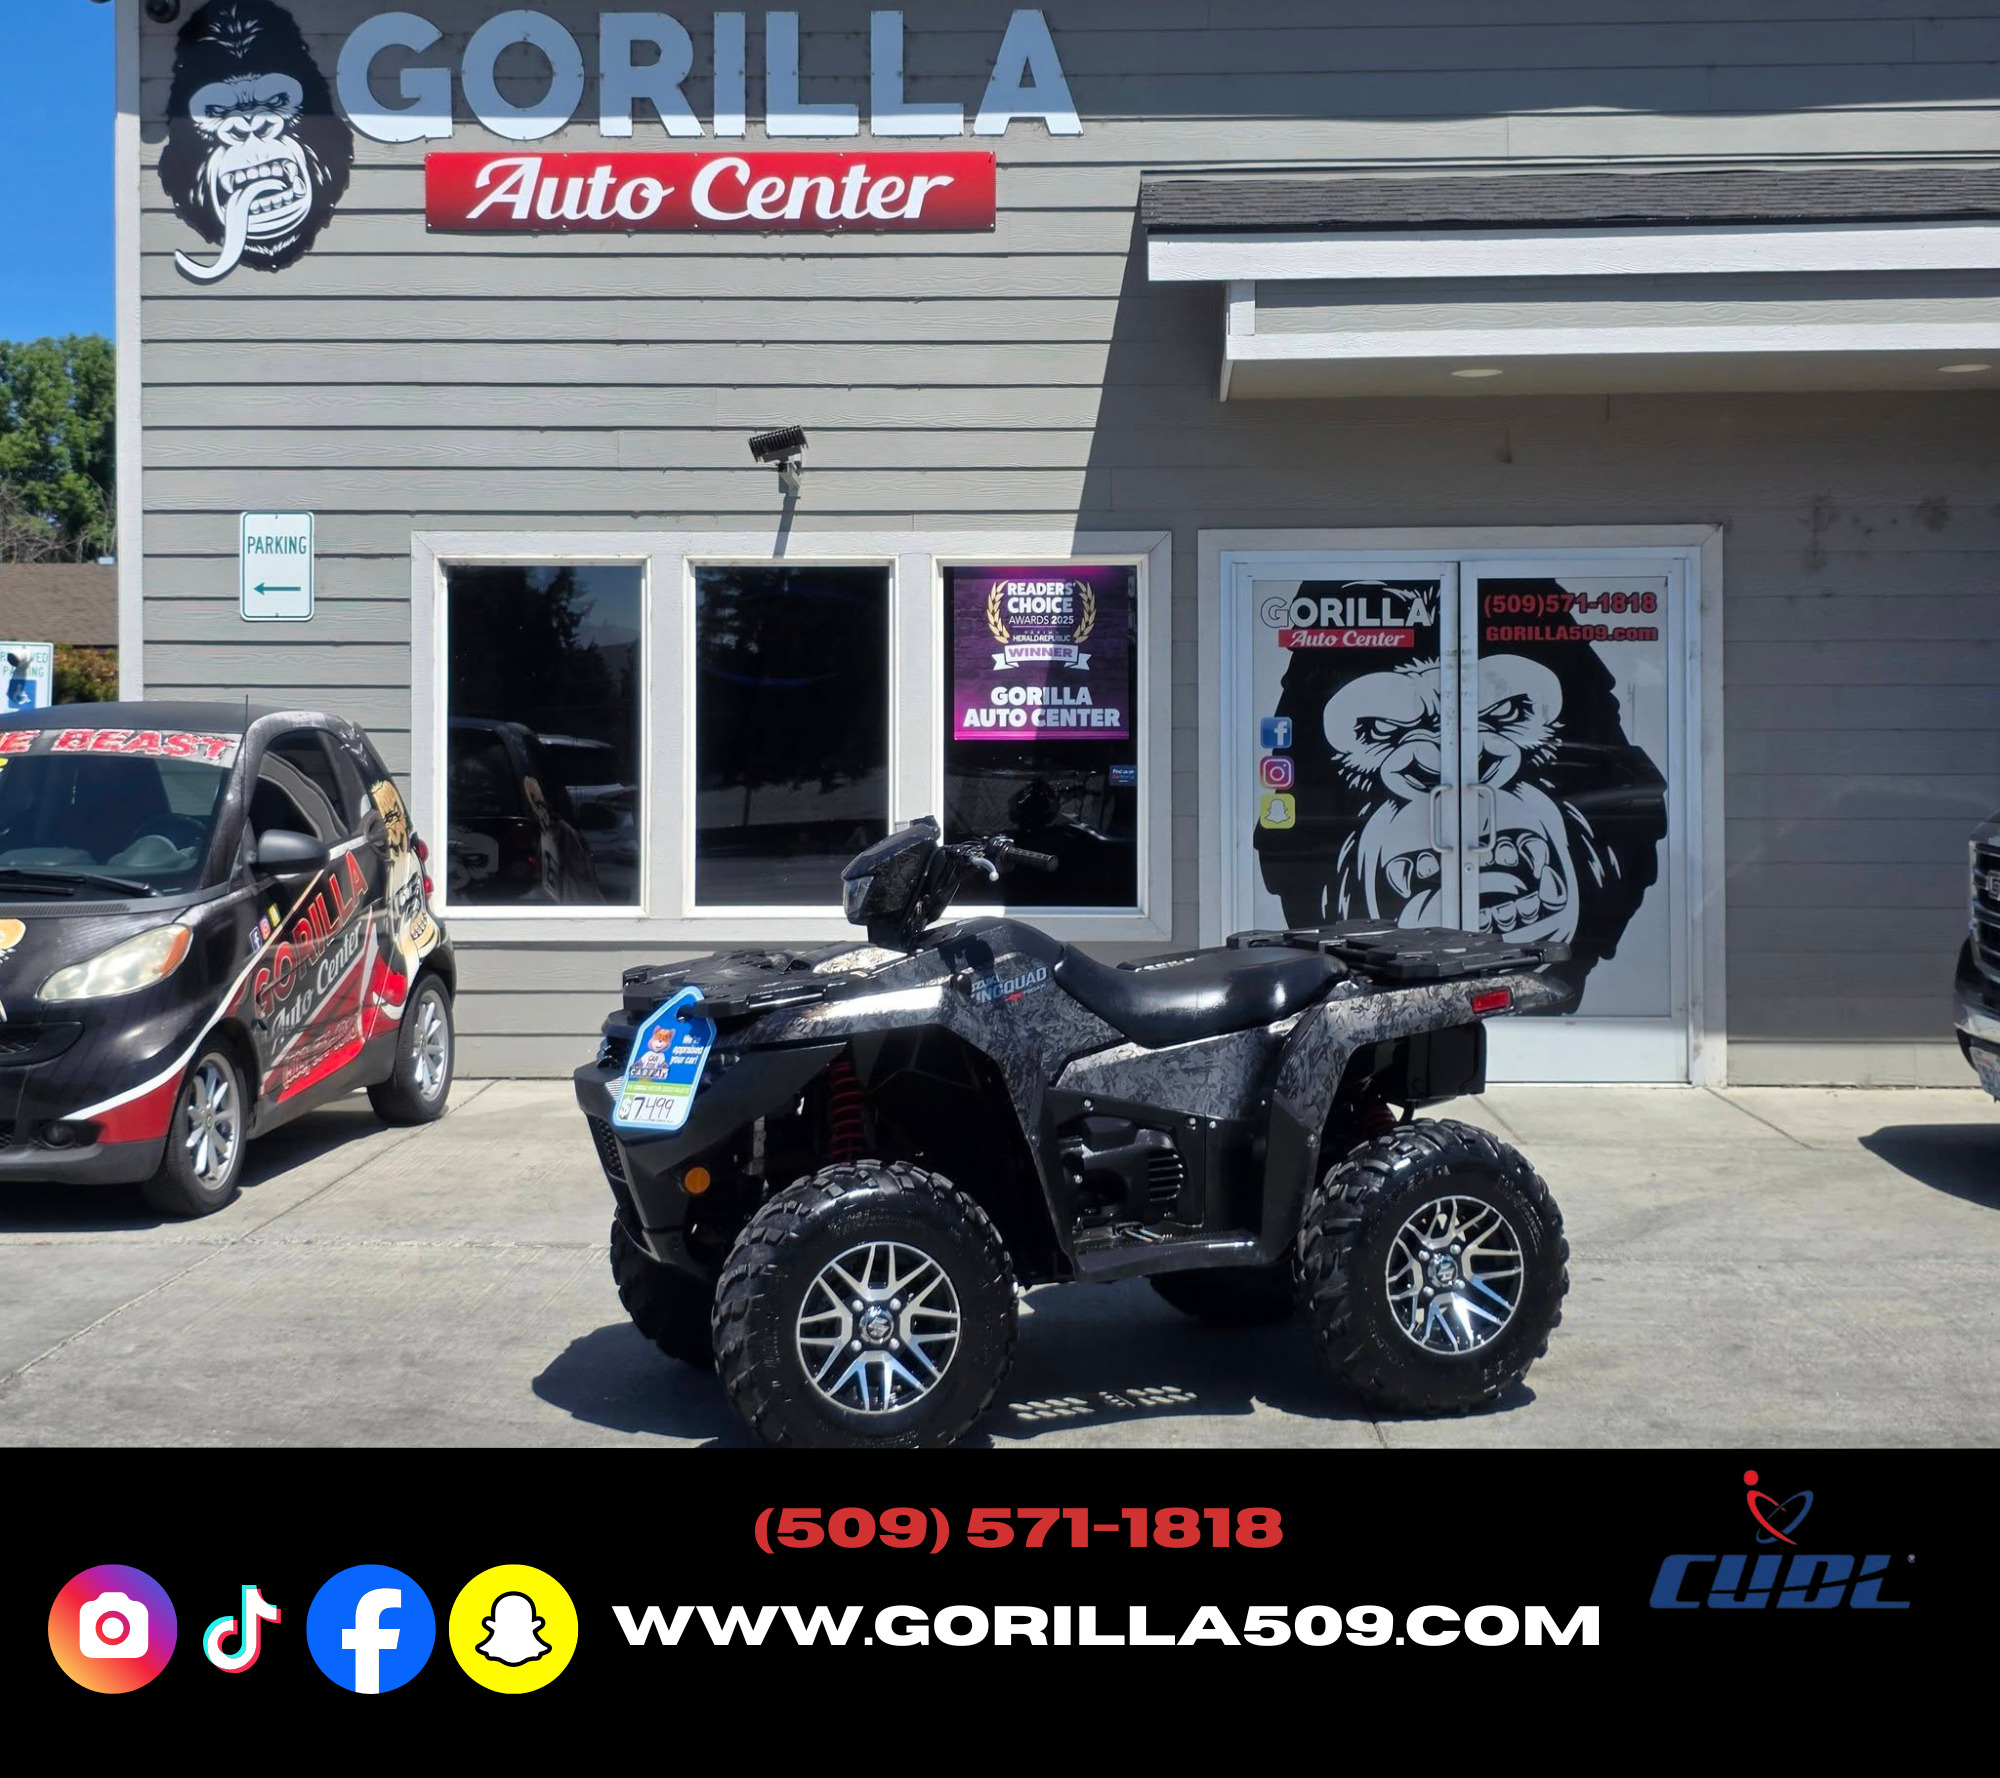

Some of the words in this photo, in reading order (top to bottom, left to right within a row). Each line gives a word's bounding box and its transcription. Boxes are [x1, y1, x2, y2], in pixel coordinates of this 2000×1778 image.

[336, 9, 1083, 142] GORILLA
[466, 157, 675, 220] Auto
[690, 157, 954, 221] Center
[247, 536, 307, 554] PARKING
[1007, 597, 1074, 614] CHOICE
[1260, 596, 1433, 629] GORILLA
[1484, 592, 1658, 617] (509)571-1818
[1008, 615, 1050, 625] AWARDS
[1051, 615, 1074, 625] 2025
[1290, 630, 1337, 647] Auto
[1342, 630, 1405, 648] Center
[1486, 625, 1658, 642] GORILLA509.com
[1008, 647, 1073, 658] WINNER
[990, 686, 1093, 706] GORILLA
[963, 708, 1028, 728] AUTO
[1031, 708, 1121, 728] CENTER
[51, 729, 240, 760] BEAST
[252, 851, 368, 1018] GORILLA
[272, 986, 314, 1055] Auto
[316, 921, 362, 997] Center
[634, 1096, 675, 1119] 7499
